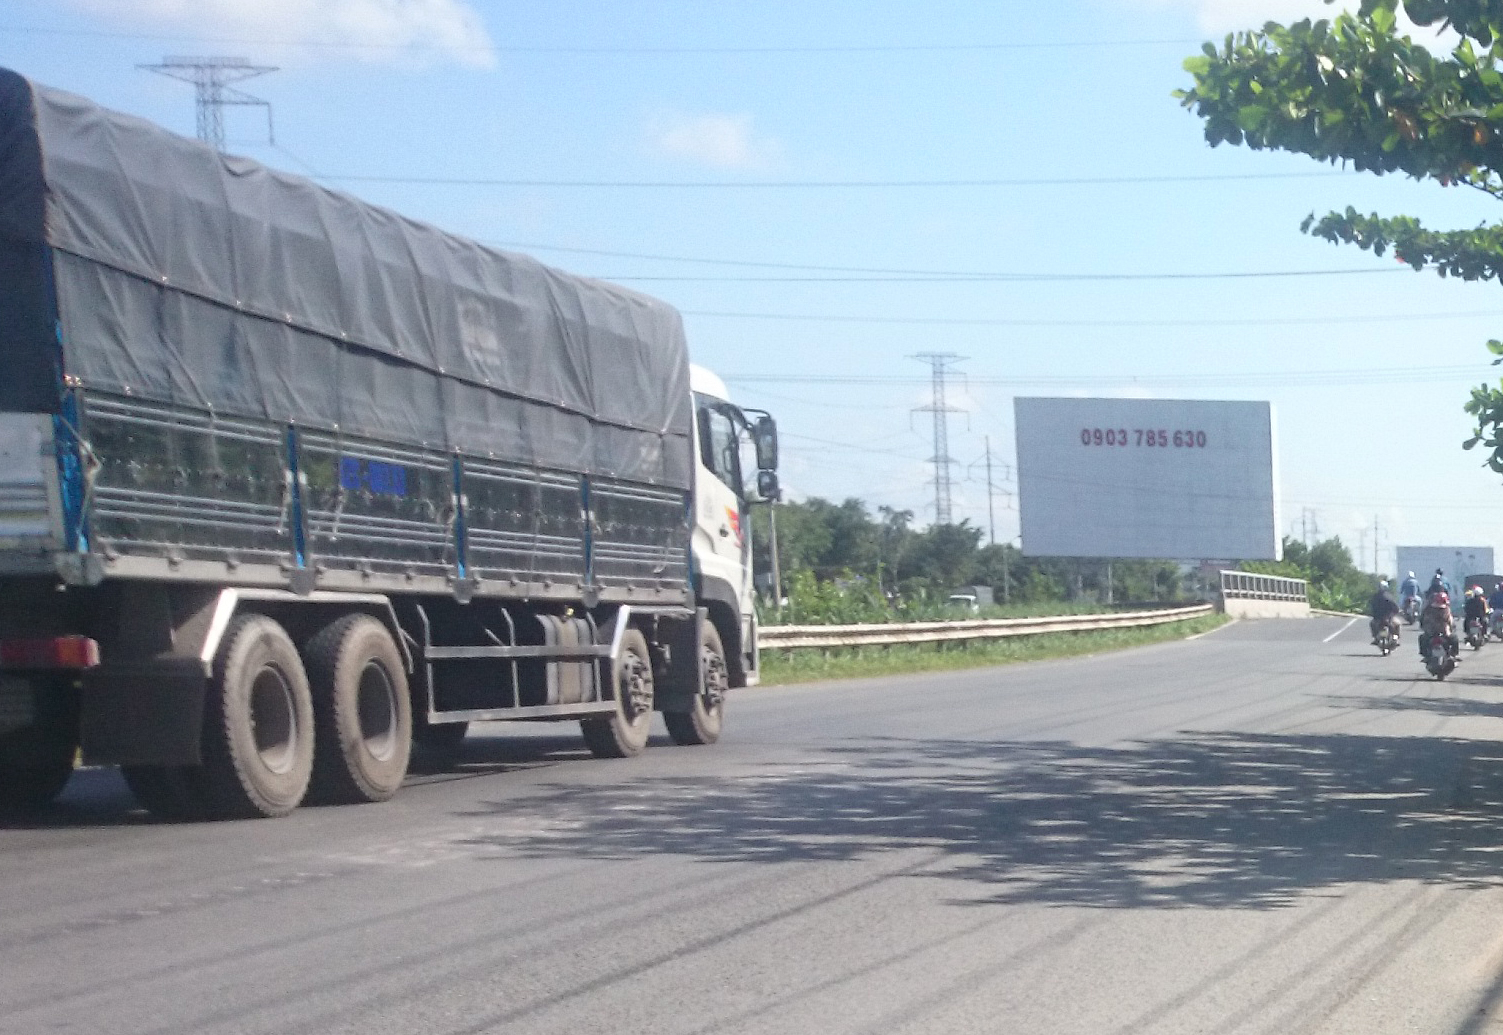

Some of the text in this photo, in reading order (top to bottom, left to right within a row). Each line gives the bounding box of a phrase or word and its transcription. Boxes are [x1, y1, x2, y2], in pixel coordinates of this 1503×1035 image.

[1081, 428, 1207, 448] 0903 785 630
